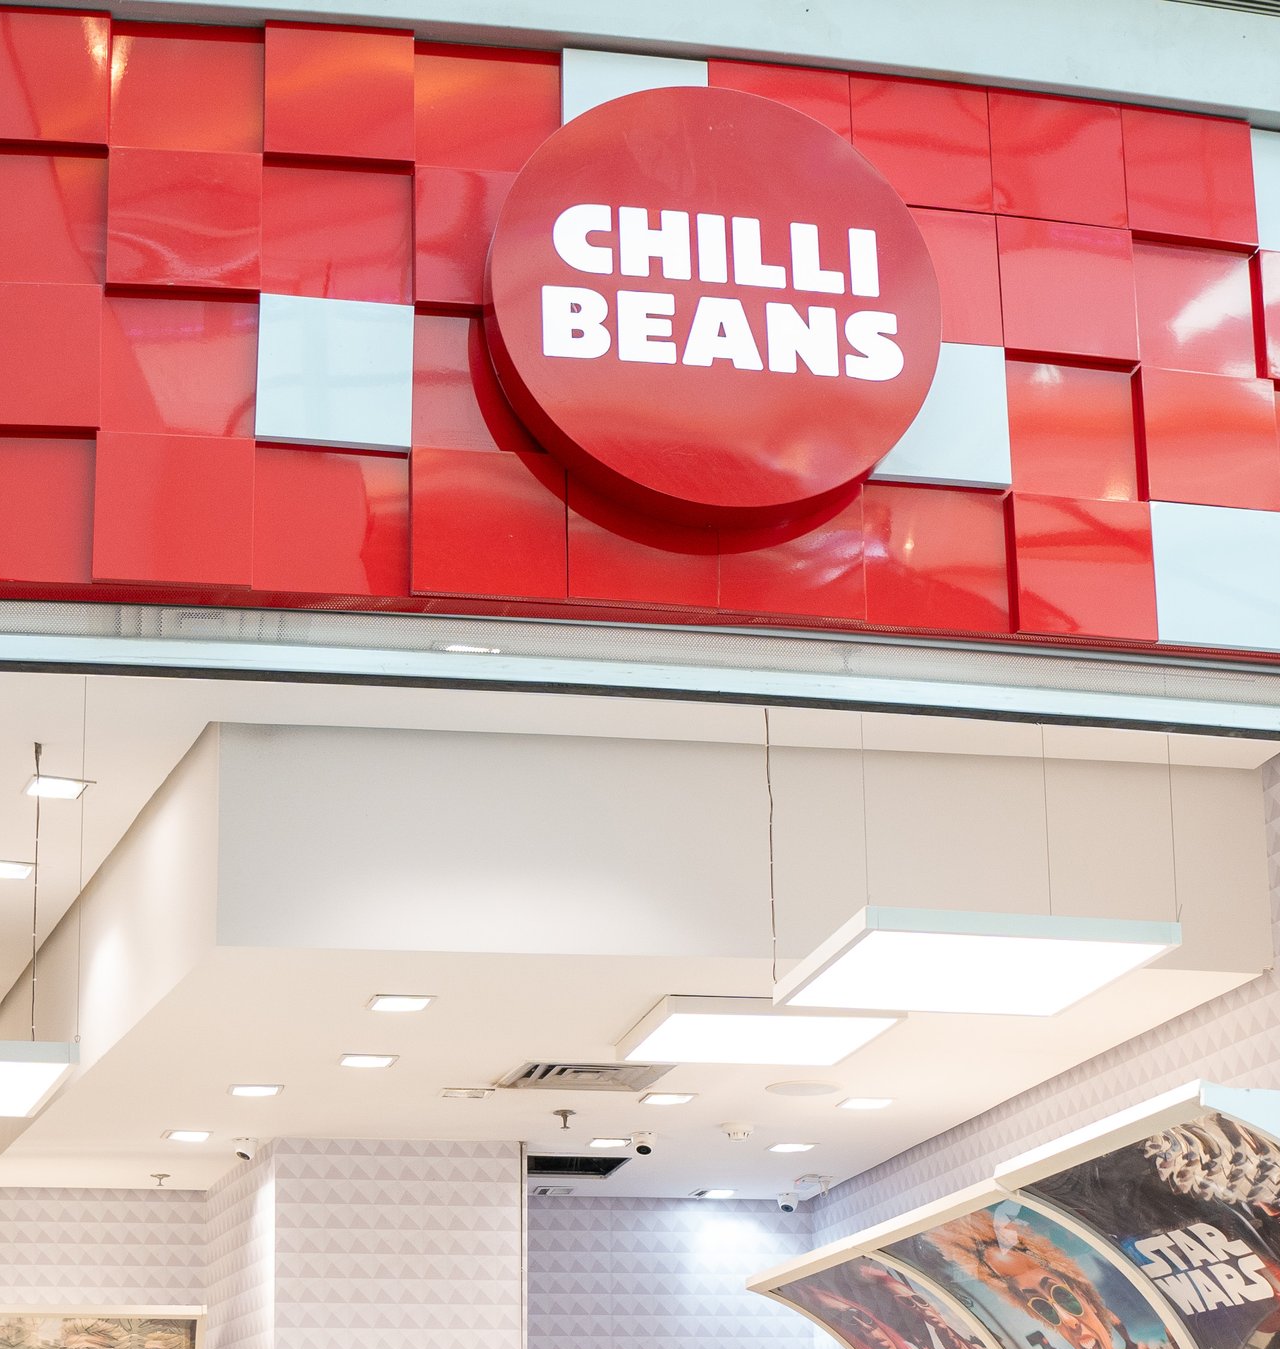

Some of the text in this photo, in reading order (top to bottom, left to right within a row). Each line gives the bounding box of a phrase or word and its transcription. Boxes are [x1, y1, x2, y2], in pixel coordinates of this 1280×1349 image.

[552, 203, 881, 298] CHILLI
[541, 285, 905, 383] BEANS
[1134, 1222, 1253, 1279] STAR
[1153, 1254, 1275, 1316] WARS
